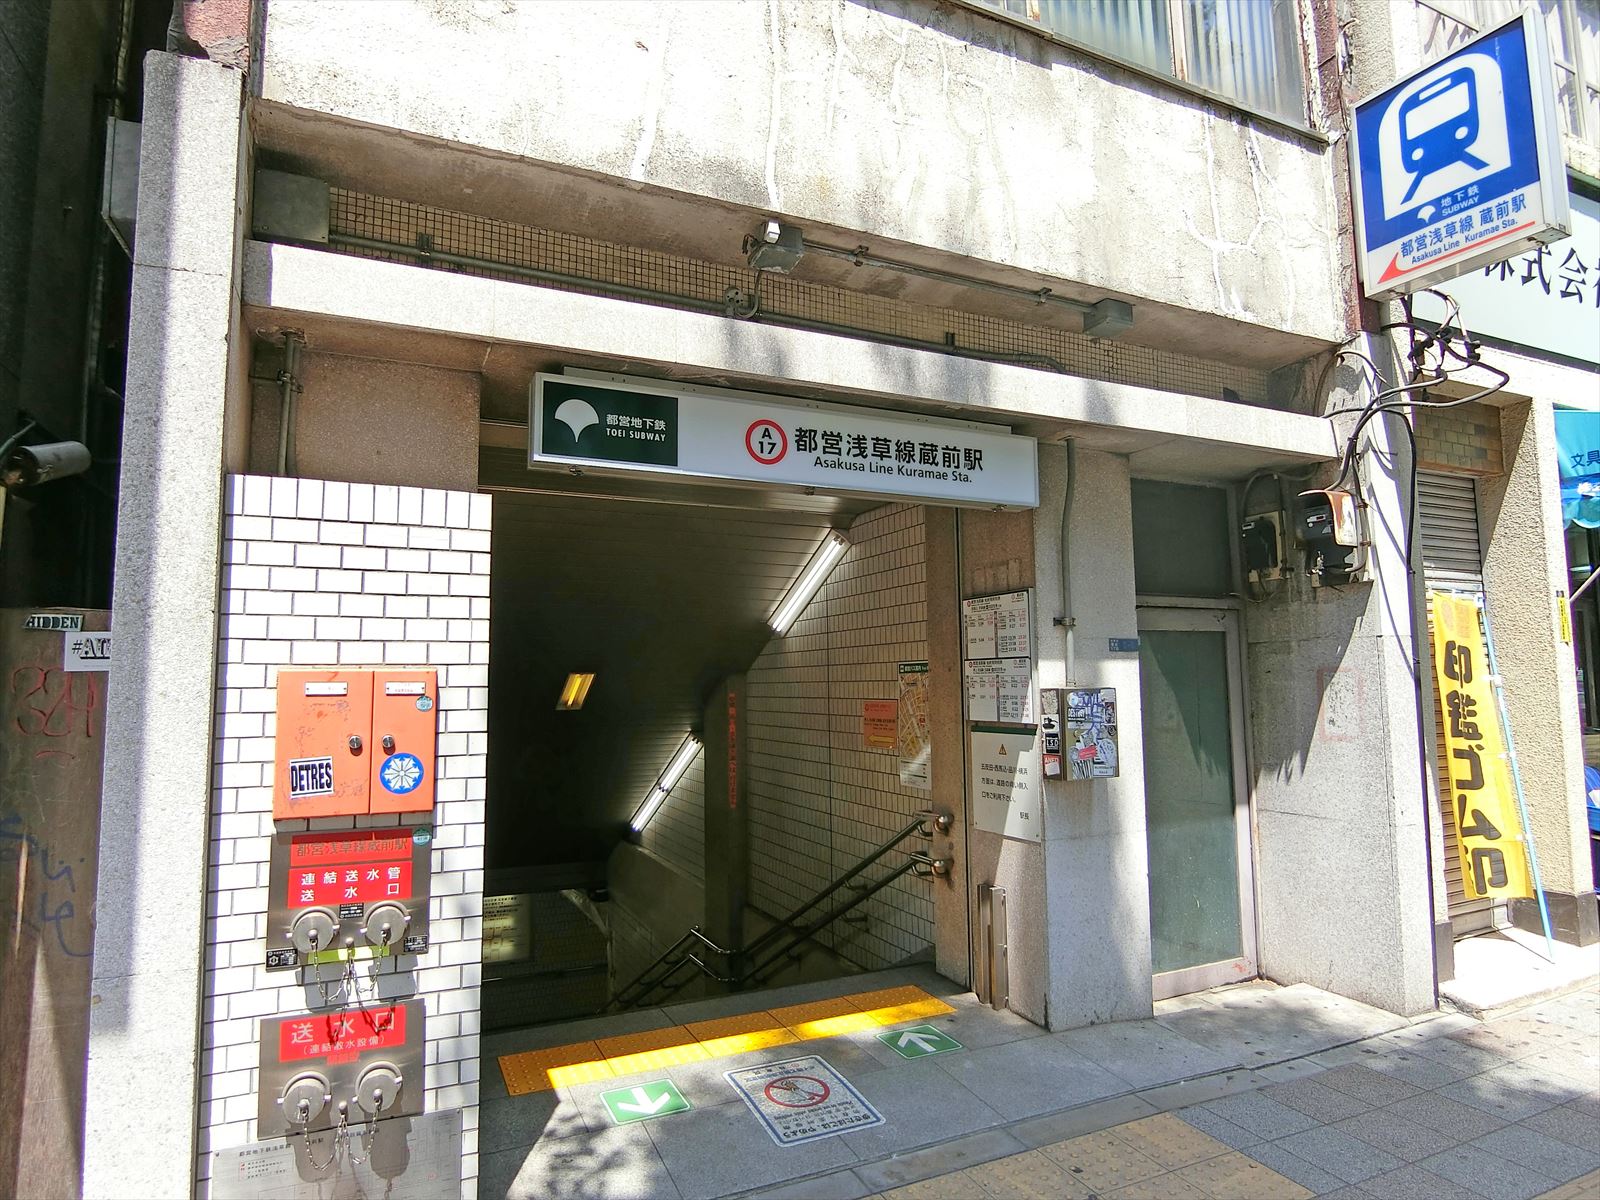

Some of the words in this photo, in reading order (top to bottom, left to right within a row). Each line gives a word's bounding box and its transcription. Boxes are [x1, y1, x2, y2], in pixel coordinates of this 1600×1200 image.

[1441, 184, 1480, 207] 地下鉄
[1442, 195, 1479, 216] SUBWAY
[1400, 215, 1474, 258] 都営浅草線
[1479, 193, 1526, 226] 蔵前駅
[1411, 245, 1442, 264] Asakusa
[1444, 240, 1460, 252] Line
[1465, 223, 1500, 243] Kuramae
[1501, 218, 1518, 229] Sta.
[1484, 246, 1600, 308] 式会
[606, 414, 666, 431] 都営地下鉄
[761, 427, 772, 440] A
[606, 428, 626, 437] TOEI
[629, 431, 666, 441] SUBWAY
[758, 440, 777, 455] 17
[794, 426, 984, 472] 都営浅草線蔵前駅
[813, 456, 865, 472] Asakusa
[869, 461, 893, 475] Line
[897, 465, 948, 481] Kuramae
[952, 470, 972, 483] Sta.
[290, 762, 332, 792] DETRES
[301, 866, 401, 886] 連結送水管
[300, 883, 400, 902] 送水口
